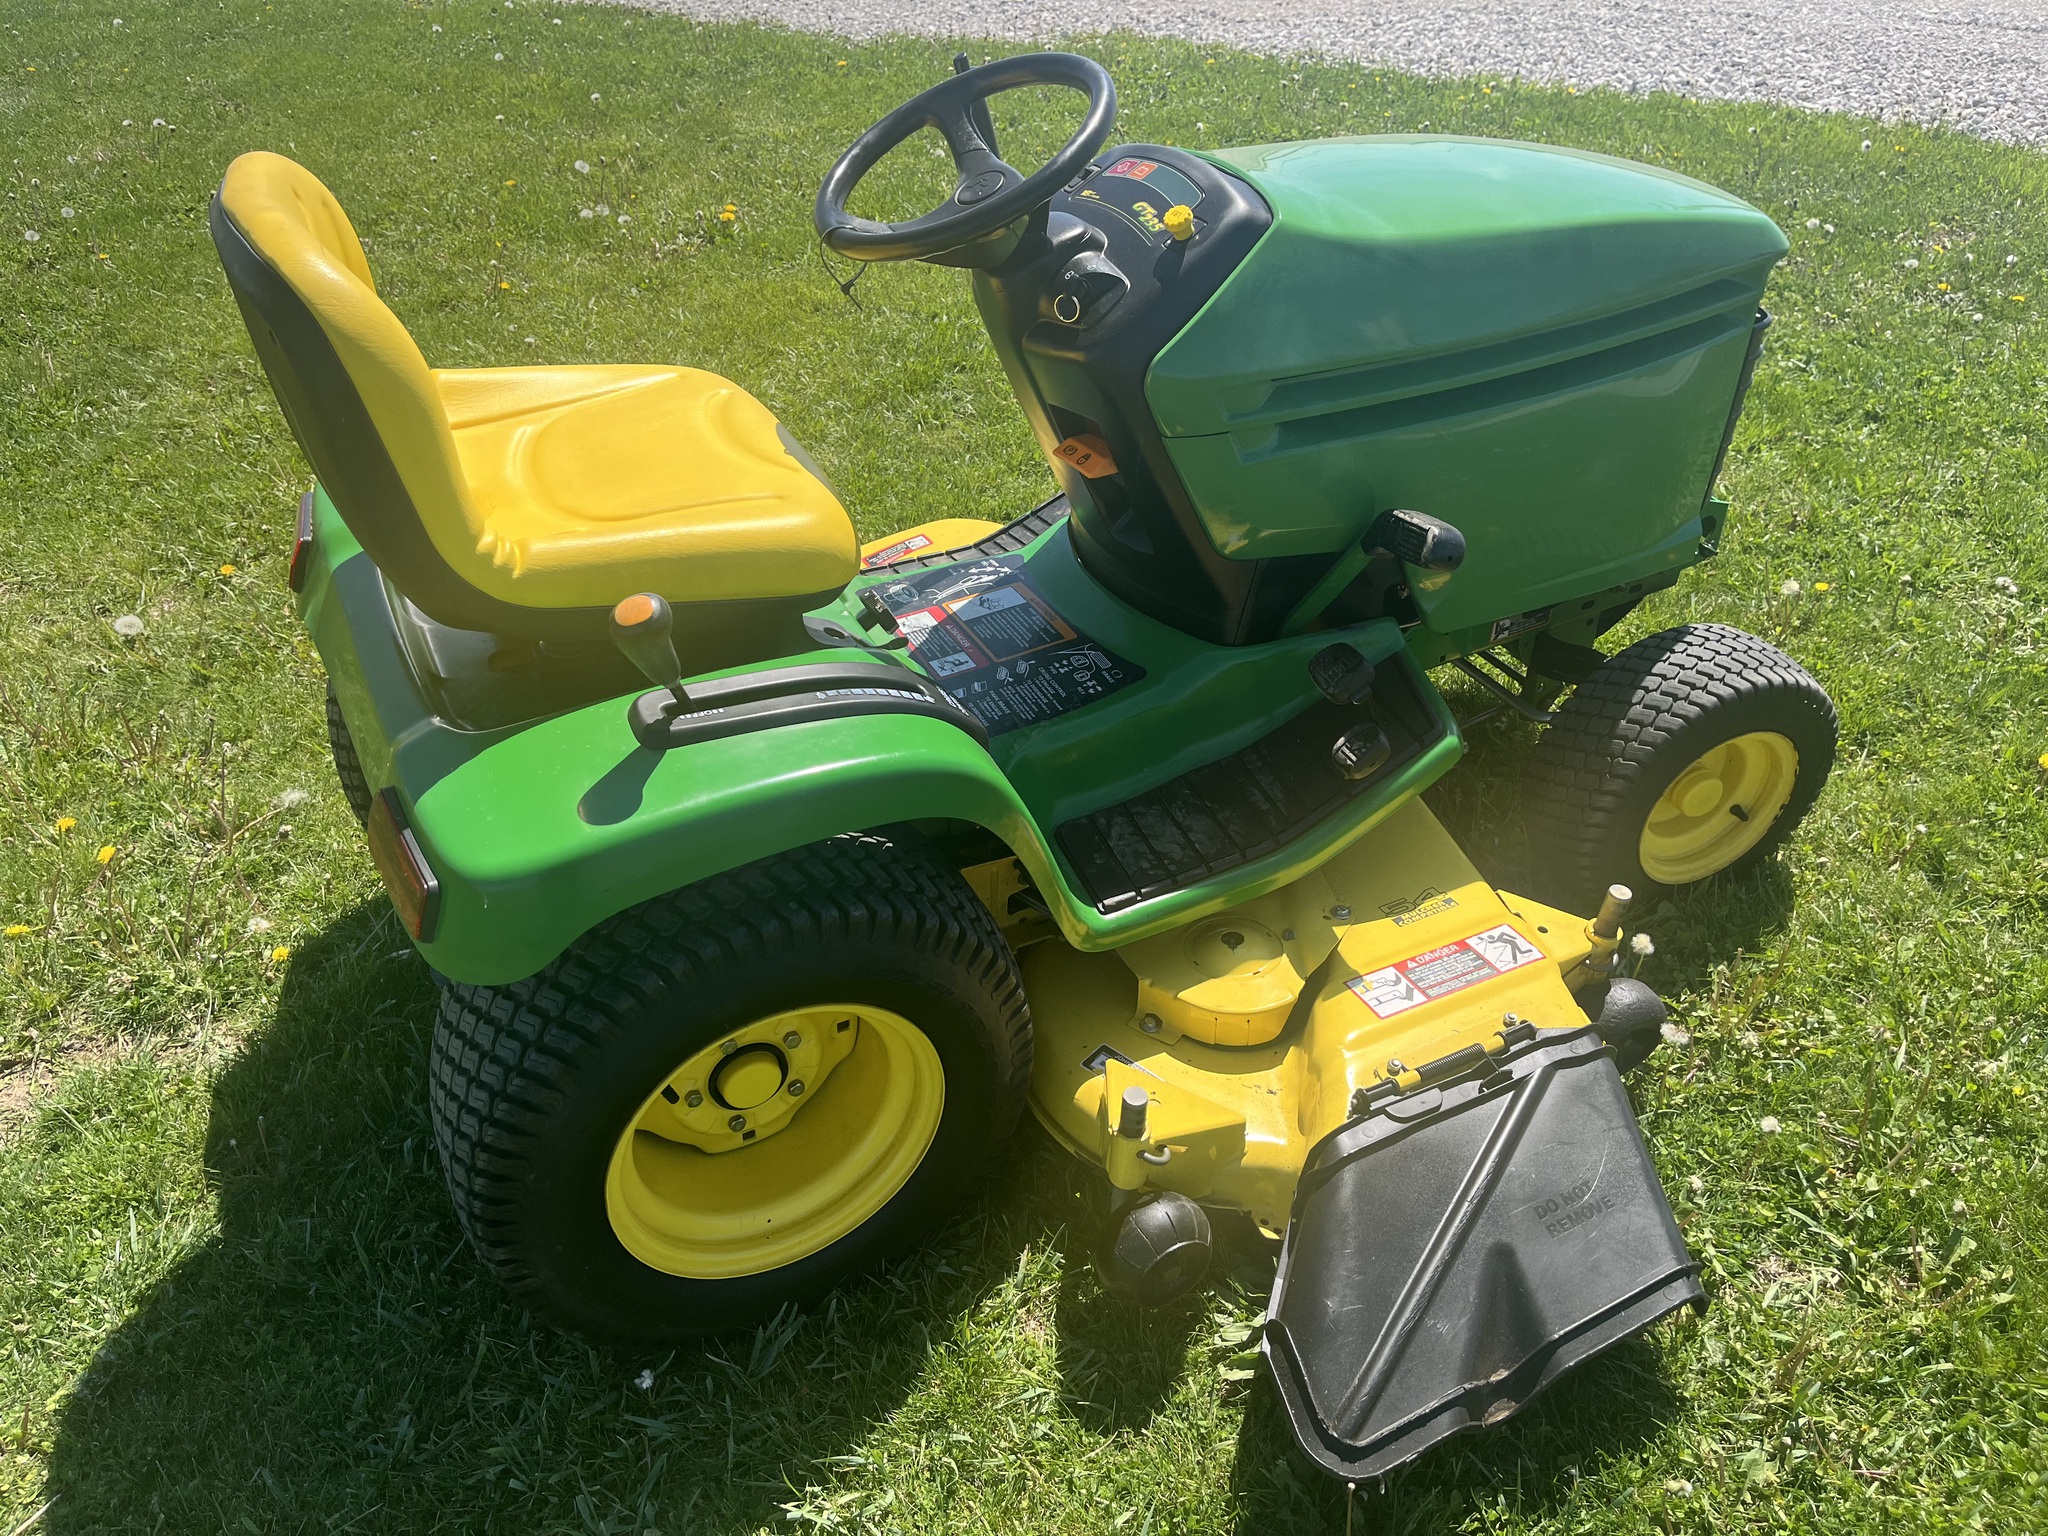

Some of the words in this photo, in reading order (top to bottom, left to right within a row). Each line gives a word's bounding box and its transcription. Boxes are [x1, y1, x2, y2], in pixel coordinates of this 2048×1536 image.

[1132, 201, 1158, 216] GT
[1138, 213, 1166, 232] 235
[949, 627, 971, 648] DANGER
[1378, 887, 1447, 917] 54
[1400, 901, 1445, 919] MULCHER
[1398, 901, 1458, 926] COMPATIBLE
[1415, 944, 1459, 964] DANGER
[1533, 1198, 1560, 1221] DO
[1559, 1180, 1592, 1208] NOT
[1545, 1196, 1616, 1239] REMOVE
